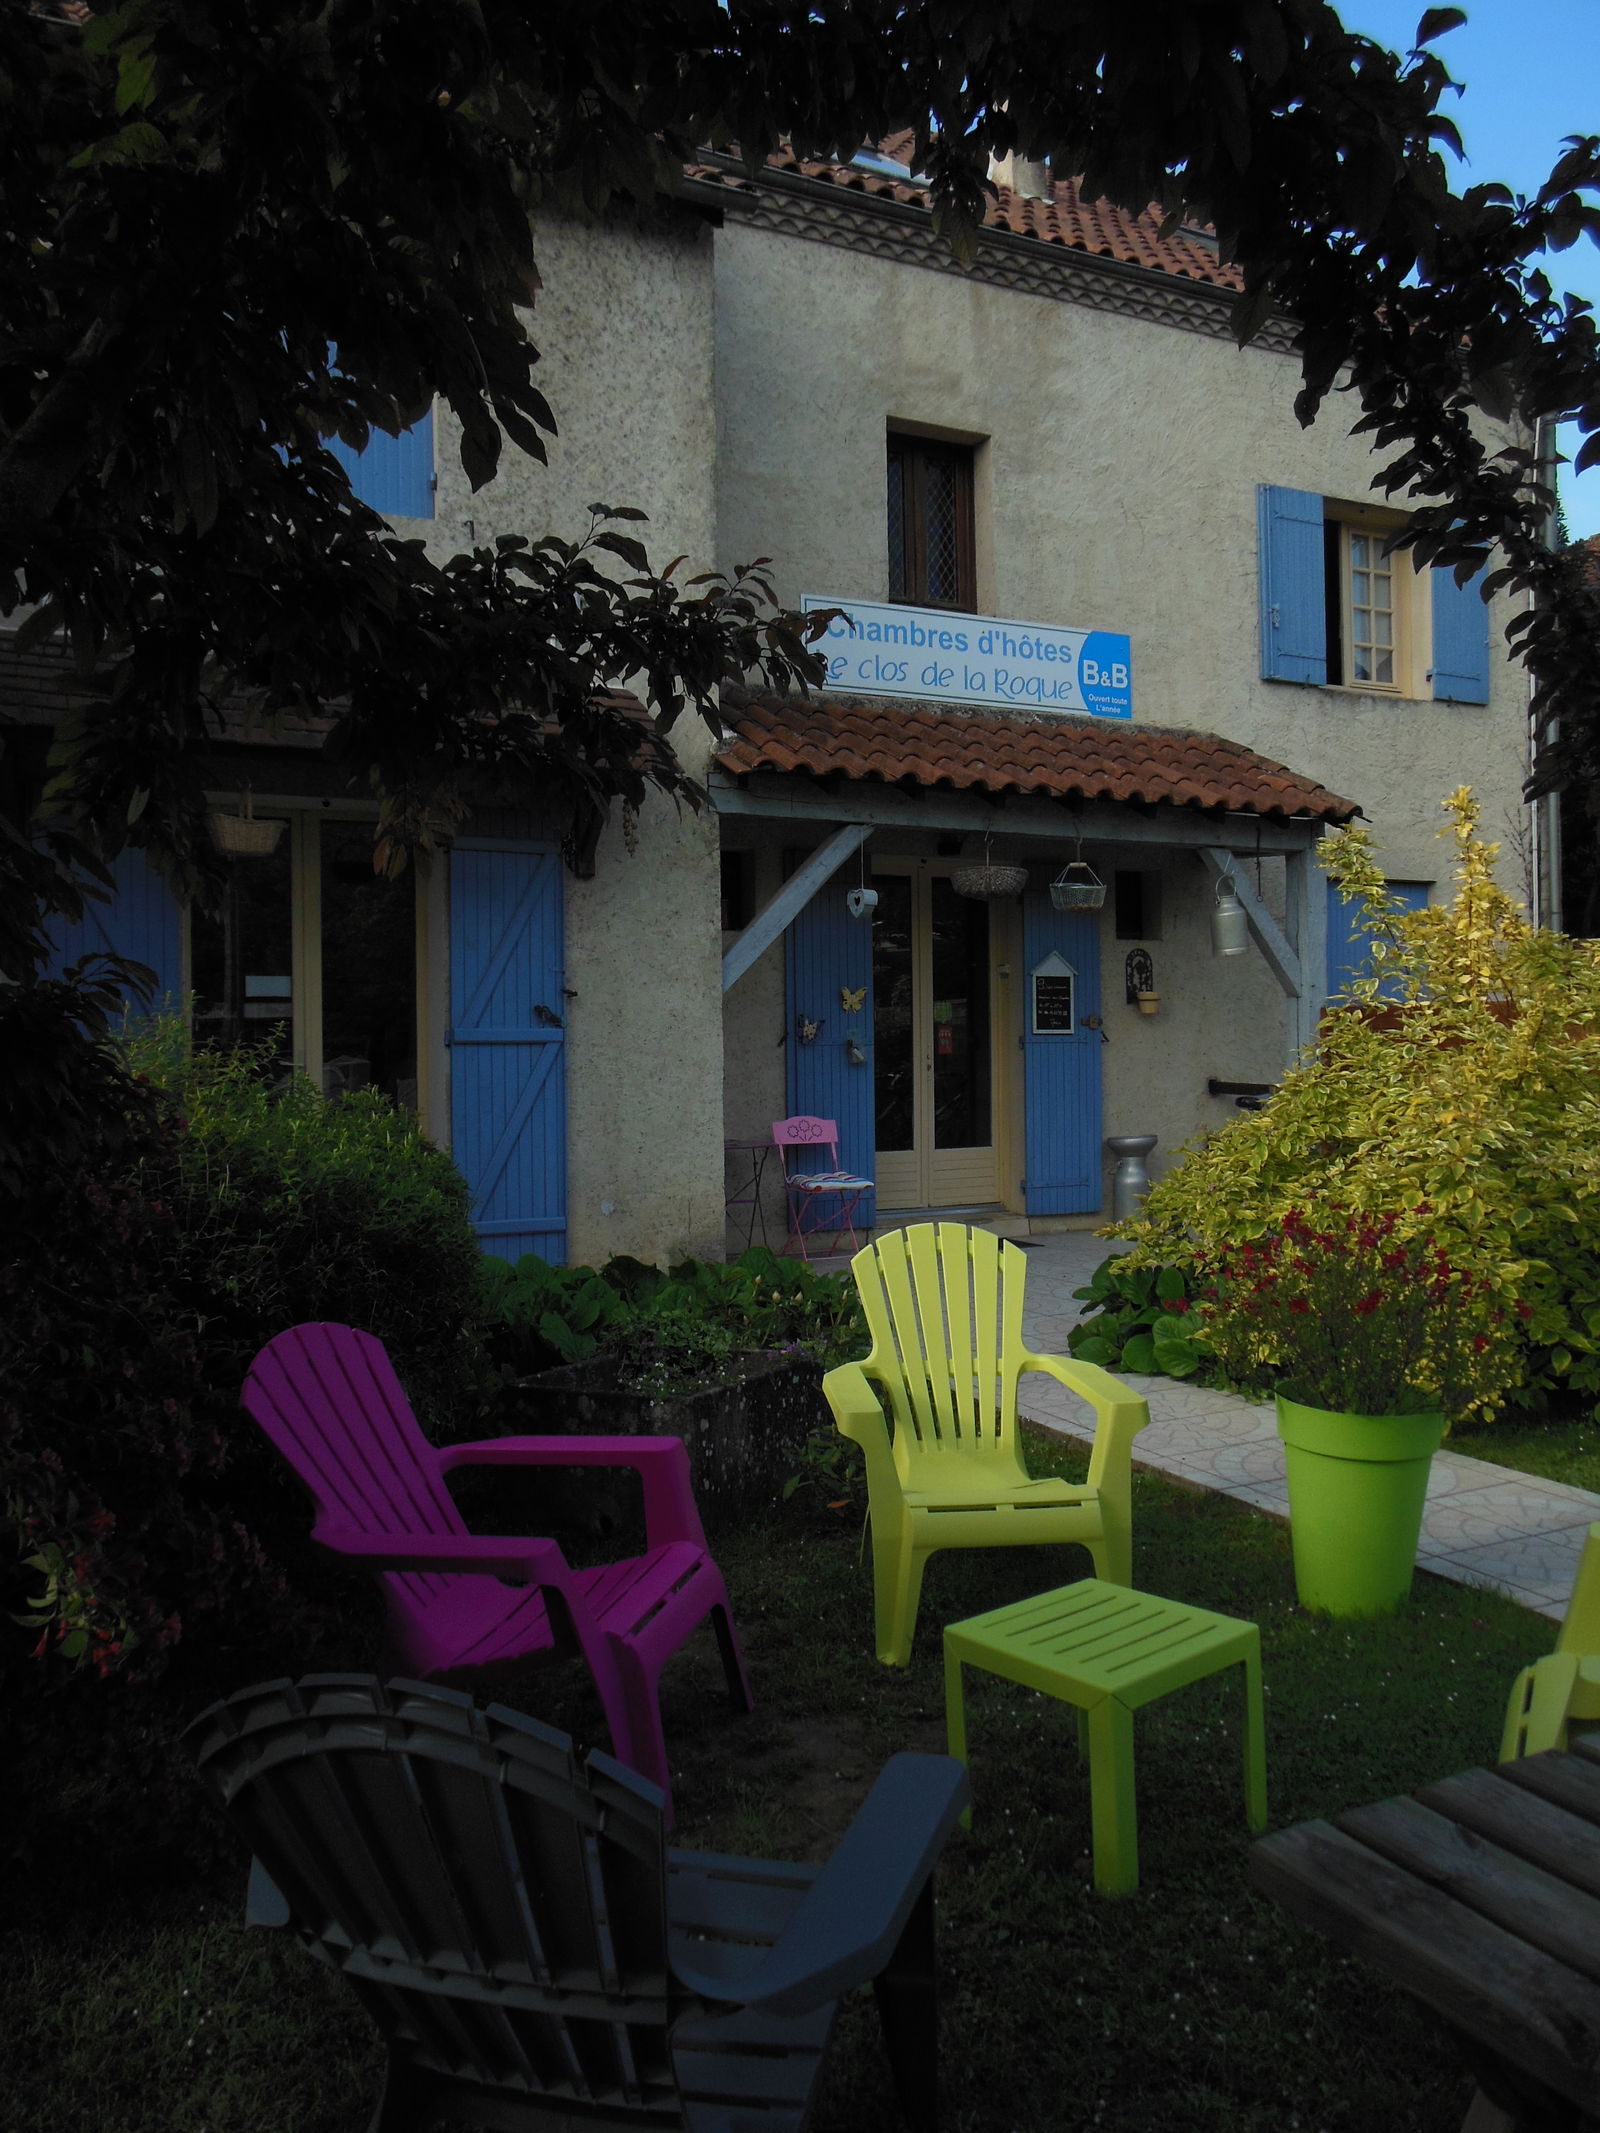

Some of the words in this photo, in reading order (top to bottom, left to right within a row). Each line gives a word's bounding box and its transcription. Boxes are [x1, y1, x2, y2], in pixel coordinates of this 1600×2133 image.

[978, 630, 1072, 663] d'hôtes
[858, 654, 909, 681] clos
[921, 661, 954, 687] de
[964, 665, 986, 691] la
[994, 668, 1073, 702] Roque
[1083, 659, 1128, 688] B&B
[1088, 693, 1110, 703] Ouvert
[1111, 697, 1128, 705] toute
